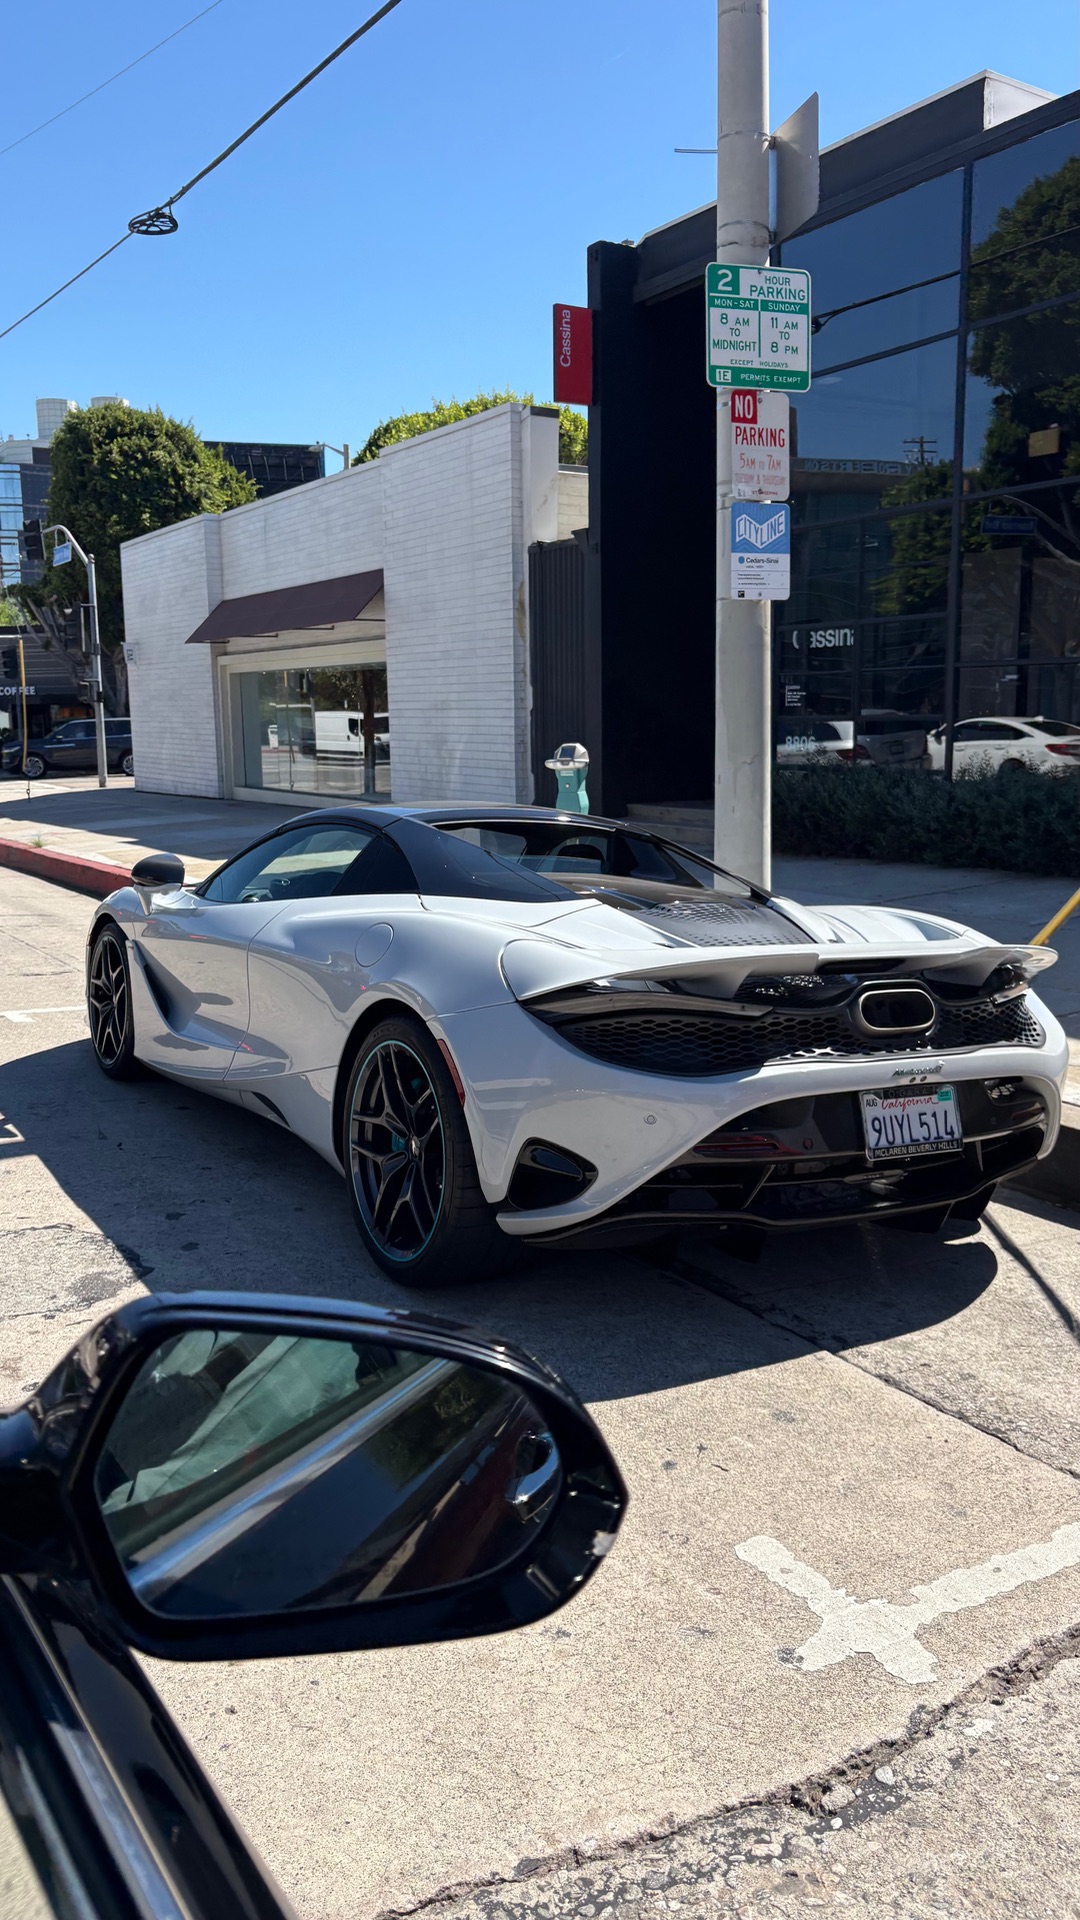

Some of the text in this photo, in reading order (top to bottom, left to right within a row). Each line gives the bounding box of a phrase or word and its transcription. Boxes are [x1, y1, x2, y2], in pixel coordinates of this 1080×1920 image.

[717, 269, 733, 291] 2
[764, 275, 791, 286] HOUR
[749, 285, 806, 301] PARKING
[767, 302, 801, 312] SUNDAY
[720, 313, 750, 327] 8 AM
[770, 317, 799, 330] 11 AM
[560, 309, 571, 367] Cassina
[729, 328, 741, 337] TO
[778, 331, 790, 340] TO
[712, 339, 757, 352] MIDNIGHT
[770, 341, 799, 355] 8 PM
[759, 361, 789, 369] HOLIDAYS
[717, 370, 801, 384] 1E PERMITS EXEMPT
[734, 394, 754, 419] NO
[735, 426, 785, 448] PARKING
[737, 511, 785, 547] CITYLINE
[0, 686, 36, 697] COFFEE
[865, 1096, 939, 1112] AUG California
[871, 1109, 955, 1147] 9UYL514
[874, 1140, 958, 1158] MCLAREN BEVERLY HILLS
